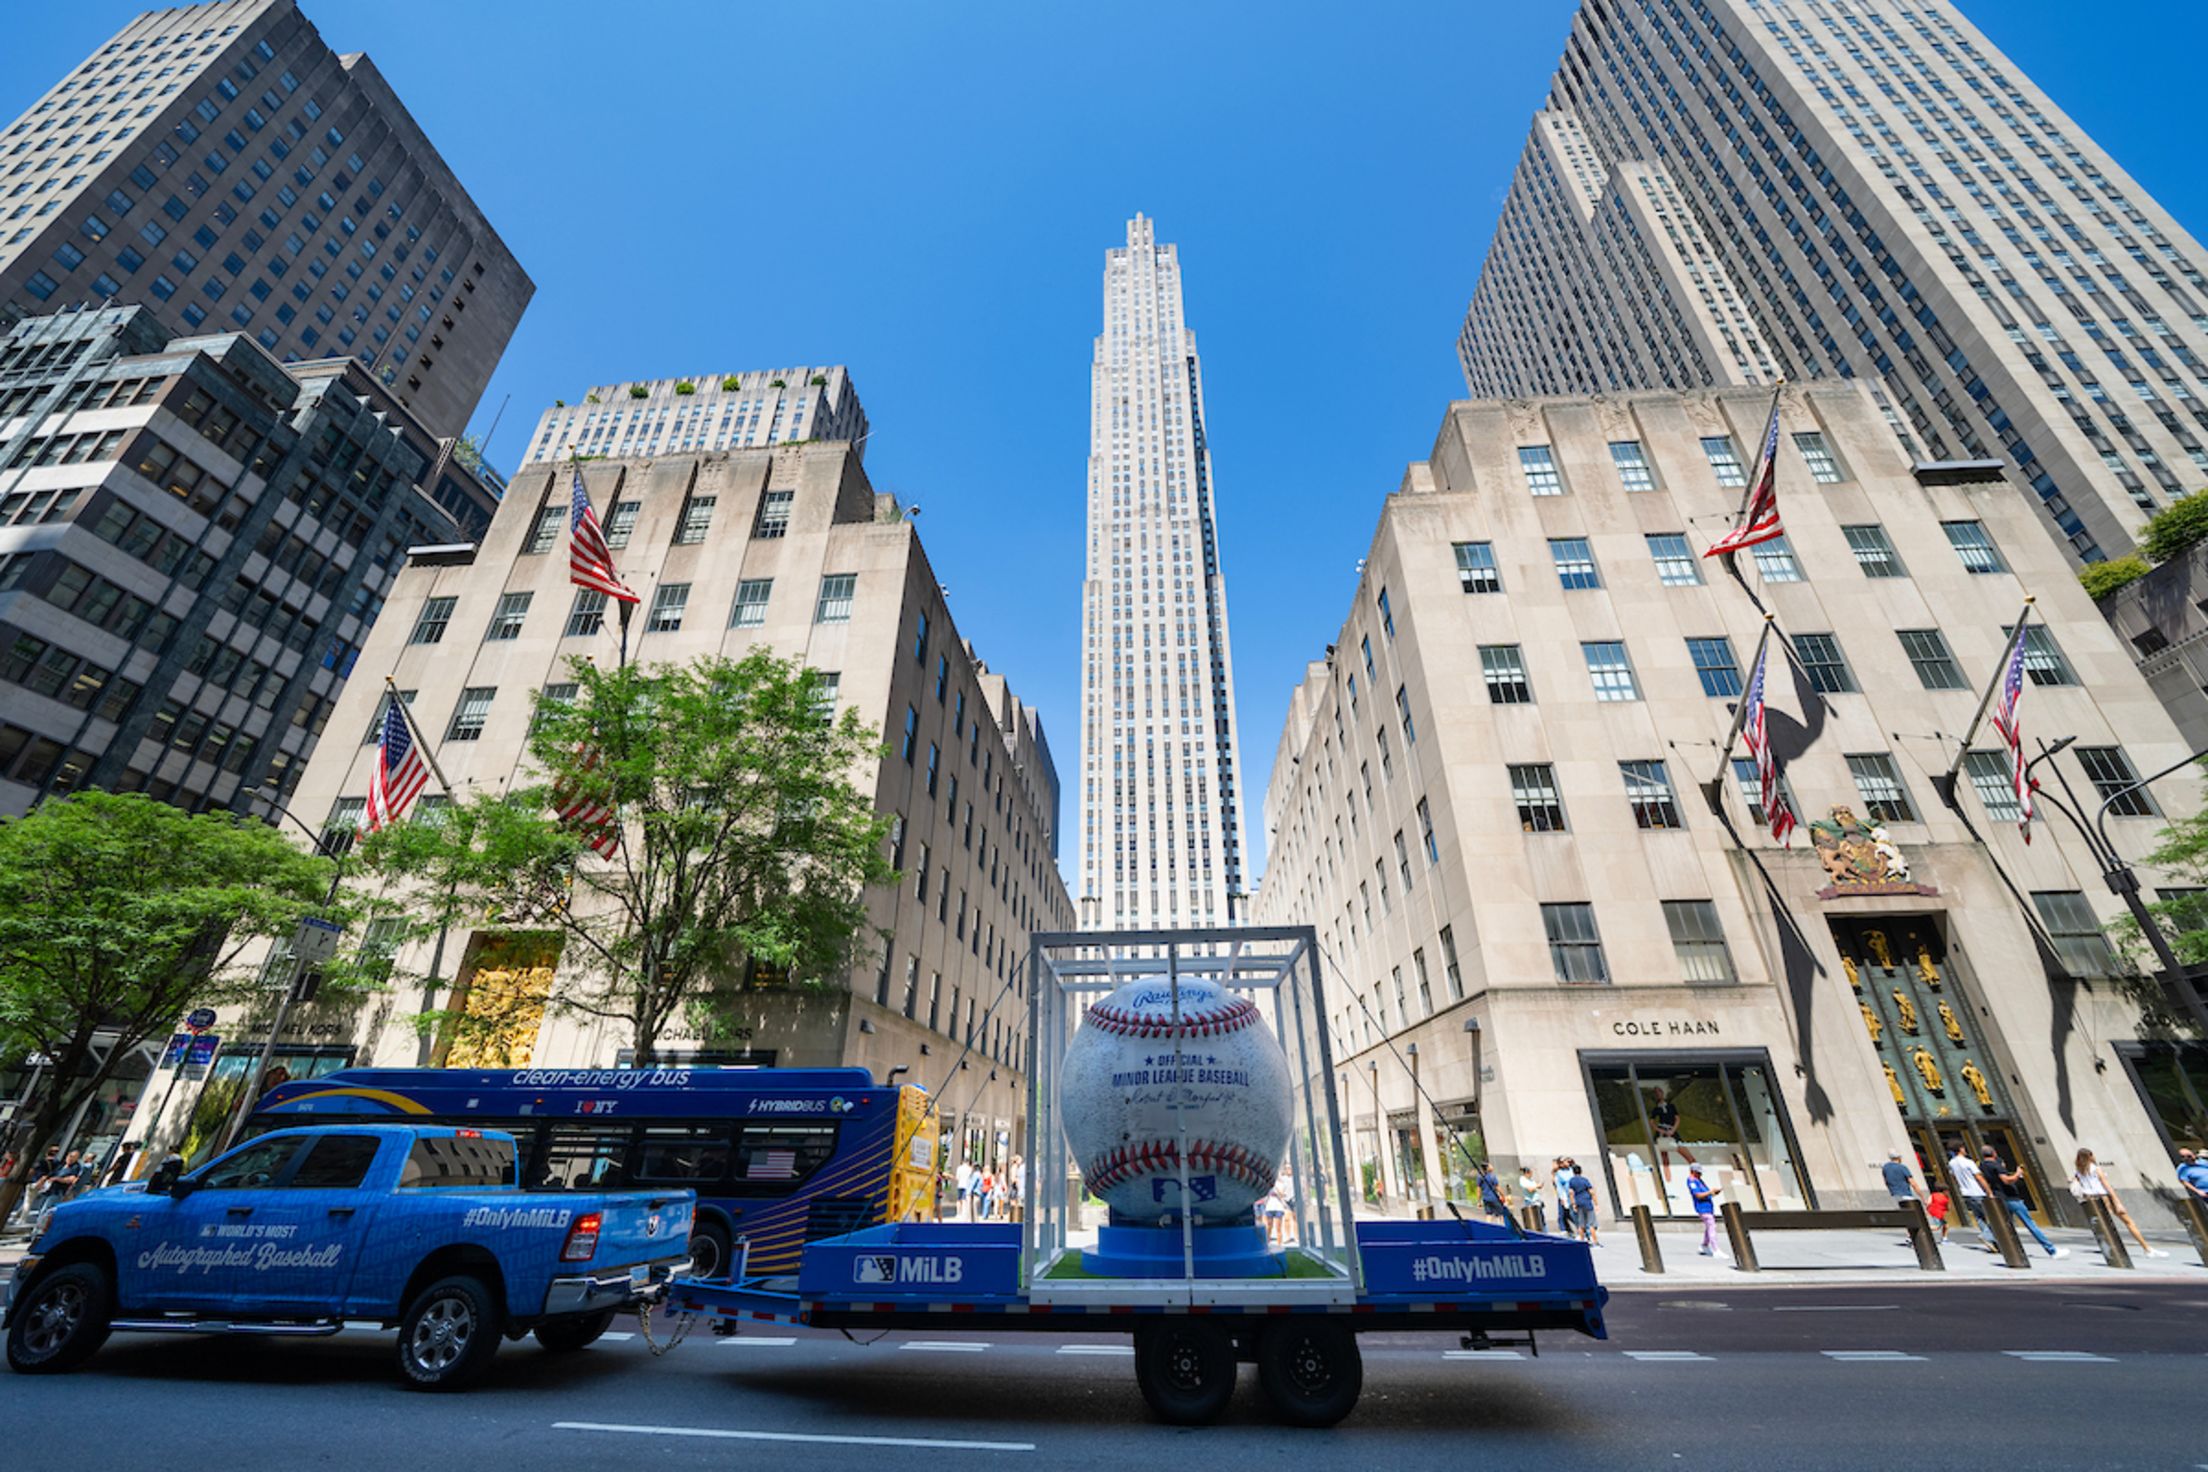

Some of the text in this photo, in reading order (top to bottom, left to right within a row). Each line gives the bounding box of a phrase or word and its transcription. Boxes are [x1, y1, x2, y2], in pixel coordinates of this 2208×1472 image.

[1133, 986, 1216, 1008] Rawings
[251, 1023, 341, 1035] MICAEL KORS
[1613, 1021, 1719, 1035] COLE HAAN
[1157, 1054, 1203, 1066] OFFCIAL
[512, 1069, 691, 1090] clean-energy bus
[1112, 1071, 1149, 1087] MINOR
[1198, 1069, 1249, 1087] BASEBALL
[463, 1206, 571, 1230] #OnlyInMiLB
[217, 1225, 298, 1238] WORLD'S MOST
[137, 1241, 258, 1275] Autographed
[253, 1242, 343, 1271] Baseball
[901, 1256, 962, 1282] MiLB
[1413, 1255, 1546, 1283] #OnlyInMiLB
